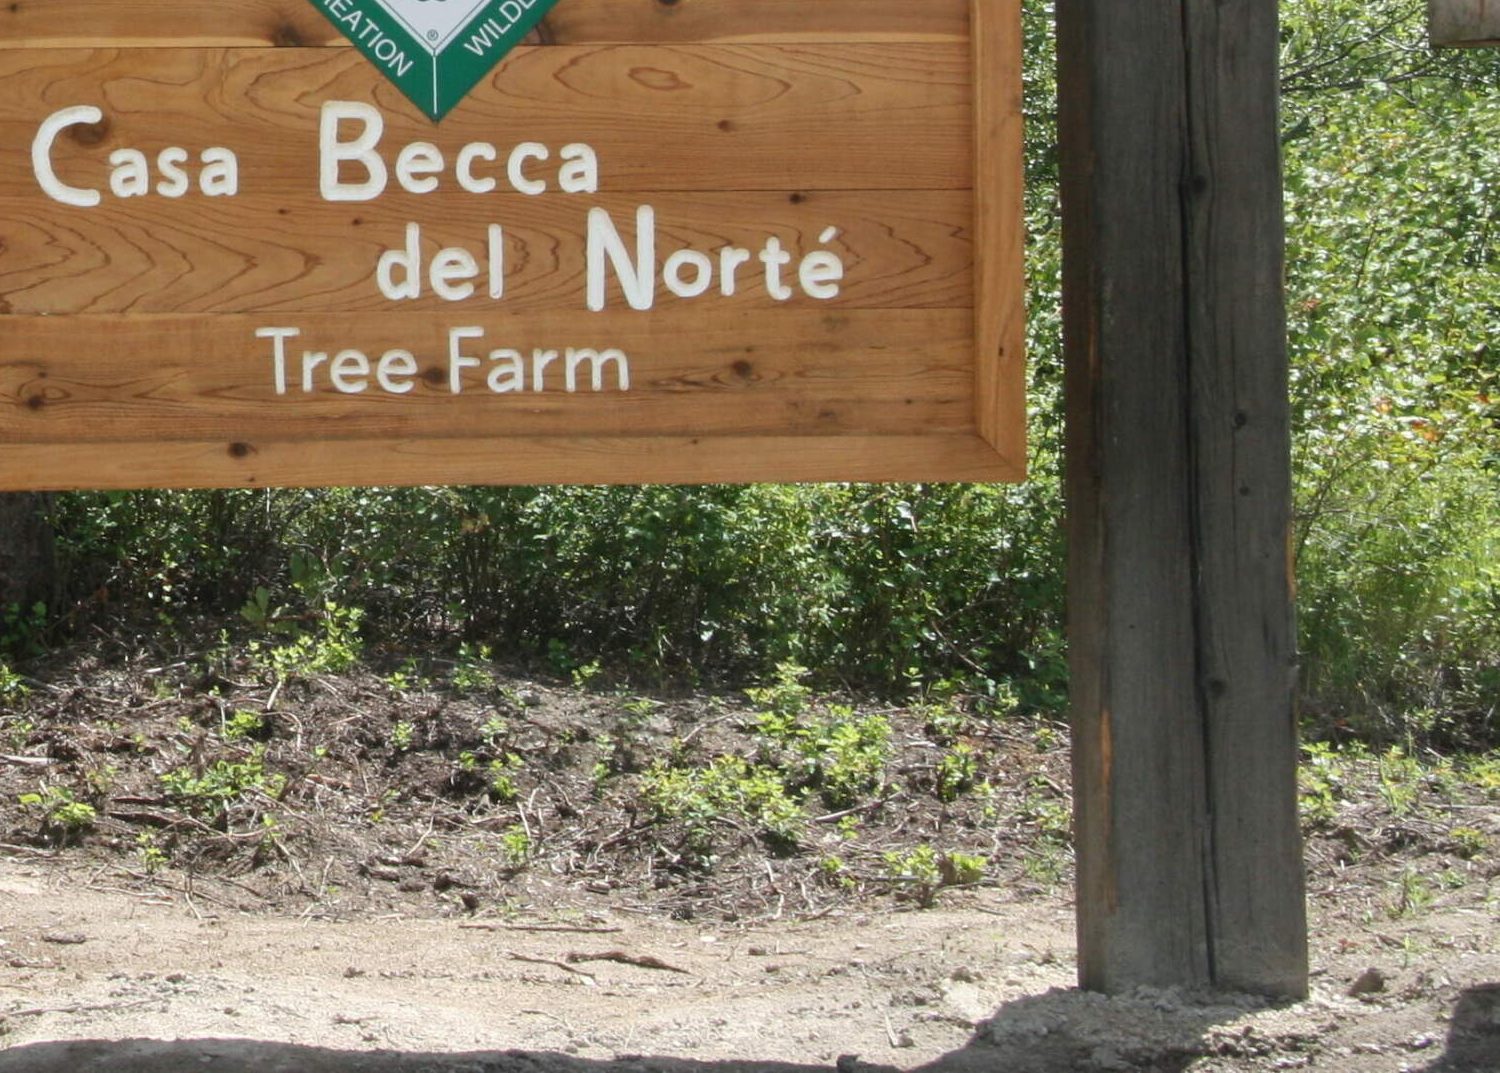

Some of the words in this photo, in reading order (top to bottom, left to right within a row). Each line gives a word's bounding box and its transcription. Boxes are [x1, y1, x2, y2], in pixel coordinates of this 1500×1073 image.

[31, 105, 238, 207] Casa
[319, 100, 598, 202] Becca
[376, 223, 504, 301] del
[586, 205, 843, 312] Norté
[255, 327, 418, 394] Tree
[449, 326, 629, 393] Farm
